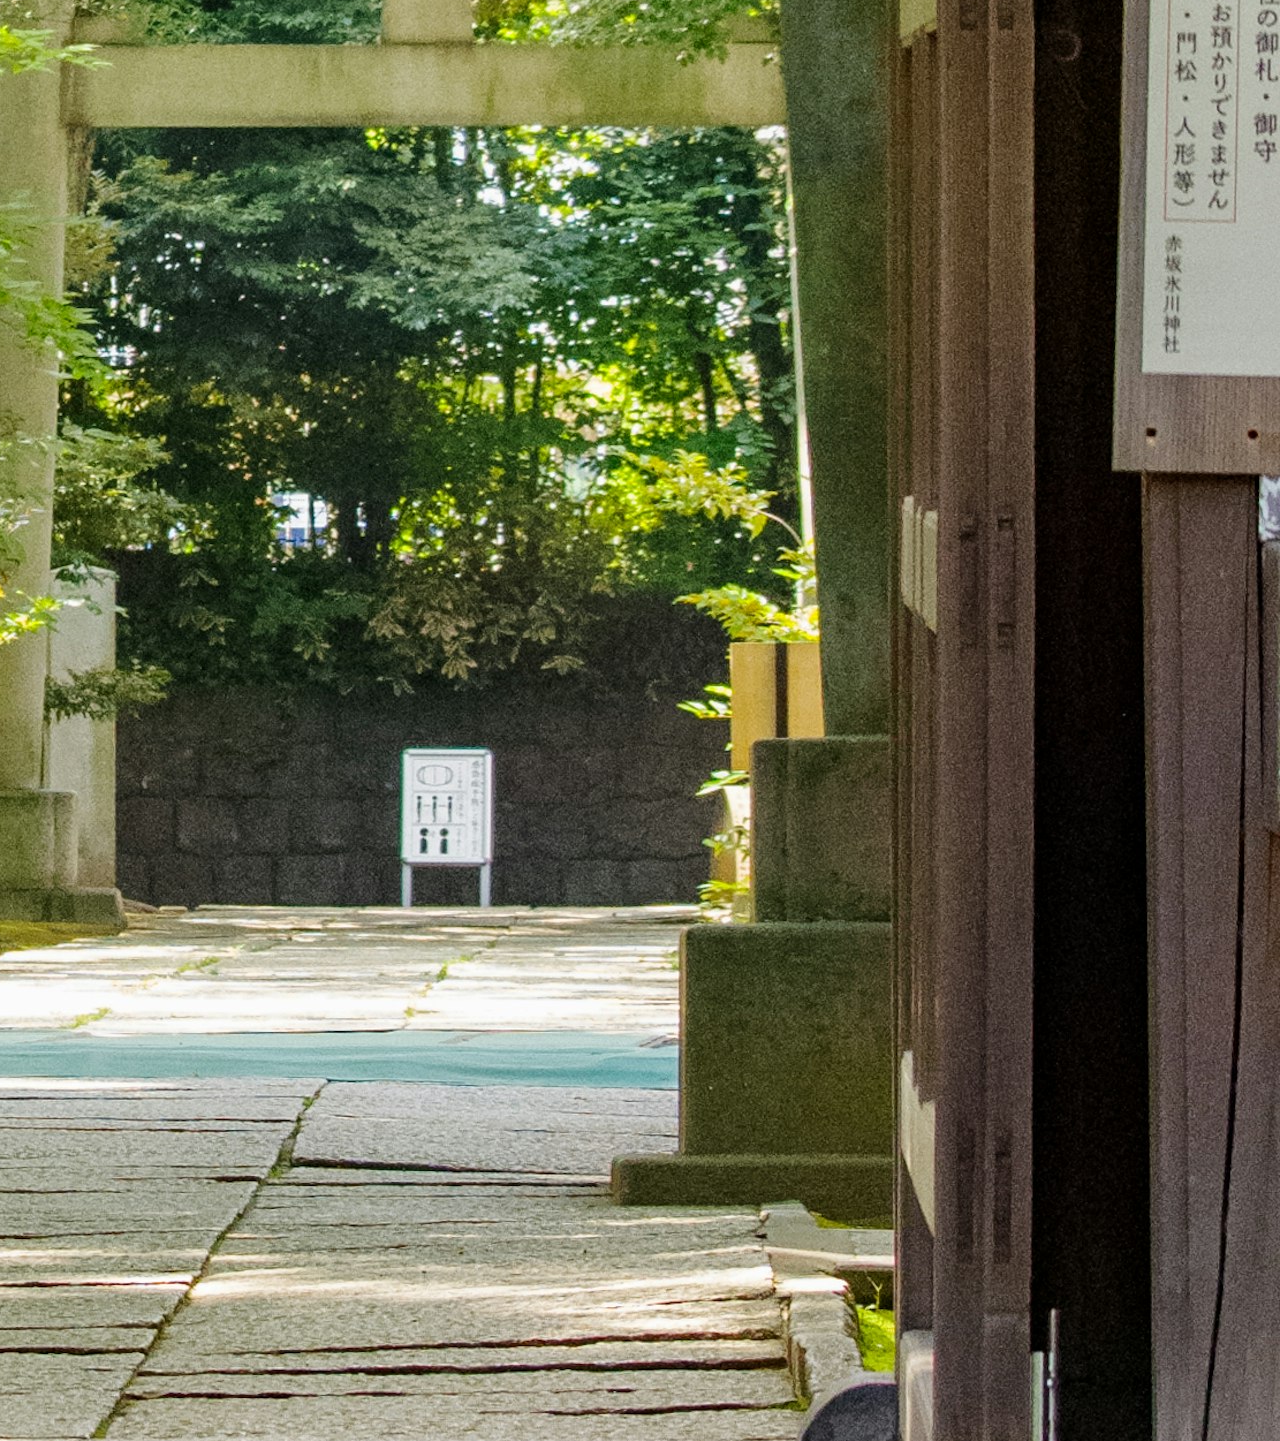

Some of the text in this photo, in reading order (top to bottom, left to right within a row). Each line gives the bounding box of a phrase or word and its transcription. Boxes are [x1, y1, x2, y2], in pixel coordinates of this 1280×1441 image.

[1163, 234, 1183, 354] 赤坂氷川神社
